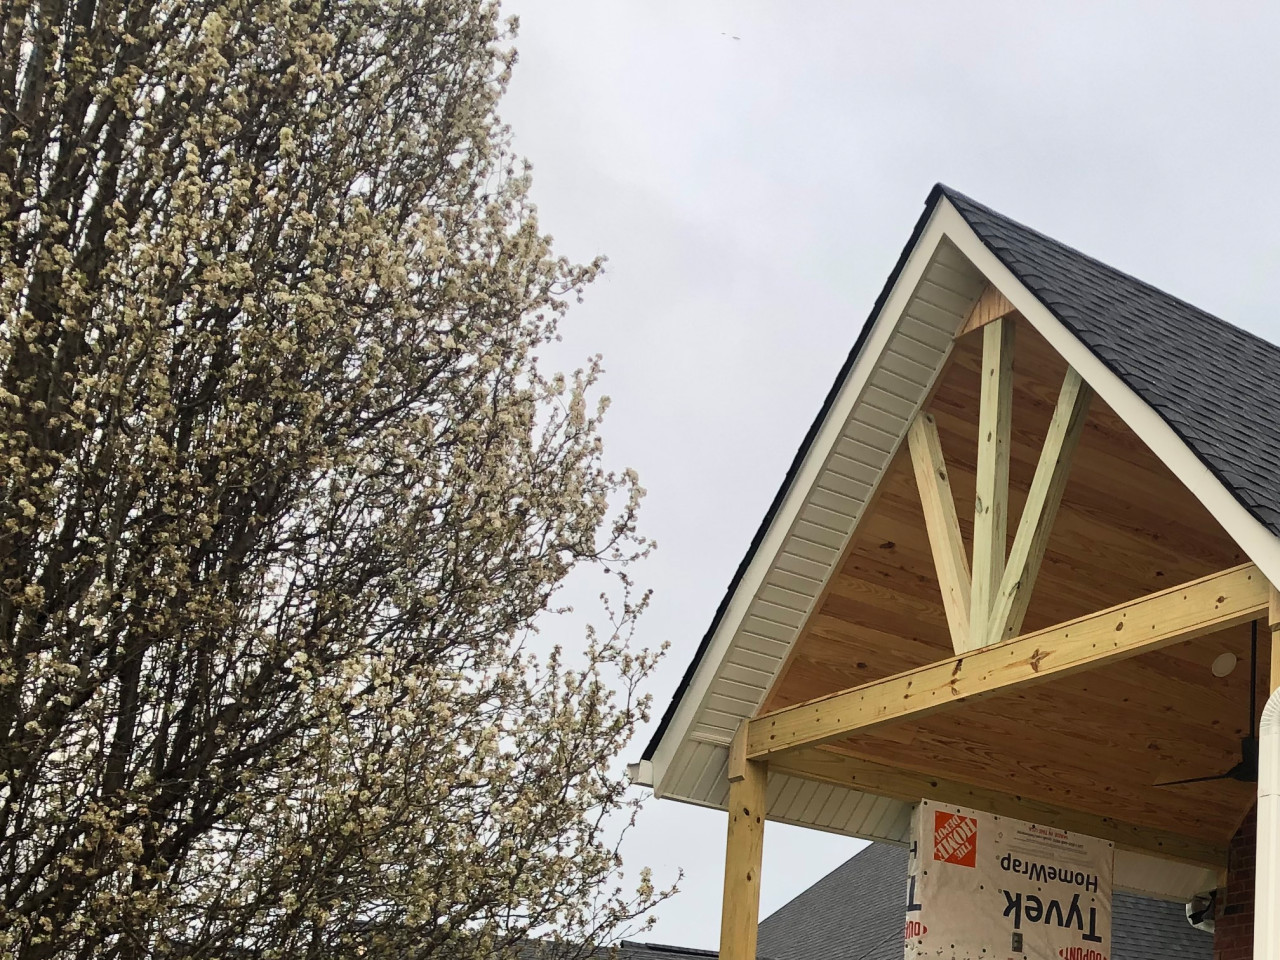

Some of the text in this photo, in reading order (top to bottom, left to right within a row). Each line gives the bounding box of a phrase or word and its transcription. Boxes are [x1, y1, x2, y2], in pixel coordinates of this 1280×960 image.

[935, 814, 961, 843] DEPOT
[935, 816, 977, 861] HOME
[954, 842, 972, 860] THE
[1000, 853, 1098, 893] HomeWrap
[1003, 890, 1102, 943] Tyvek
